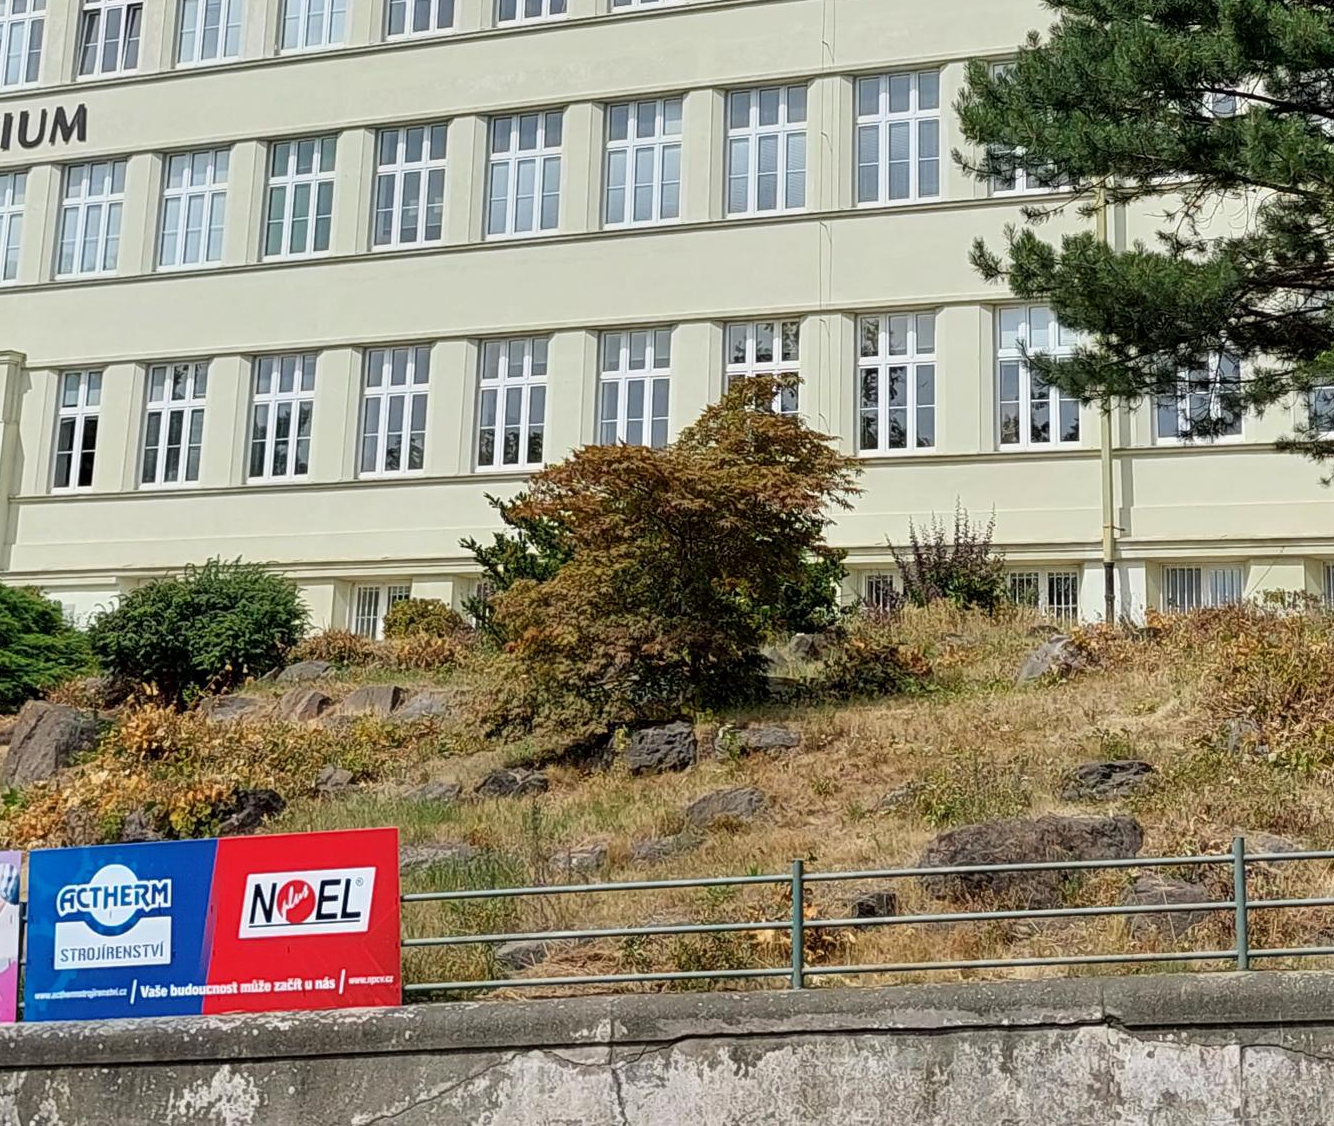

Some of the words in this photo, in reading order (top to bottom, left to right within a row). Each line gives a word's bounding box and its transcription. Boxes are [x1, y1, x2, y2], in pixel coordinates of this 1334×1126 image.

[60, 883, 169, 913] ACTHERM
[250, 879, 362, 924] NOEL
[281, 885, 310, 922] plus
[61, 941, 165, 964] STROJÍRENSTVÍ
[141, 985, 169, 999] Vaše
[171, 982, 238, 997] budoucnost
[241, 979, 271, 993] může
[274, 979, 303, 992] začít
[305, 979, 313, 990] u
[315, 976, 336, 990] nás
